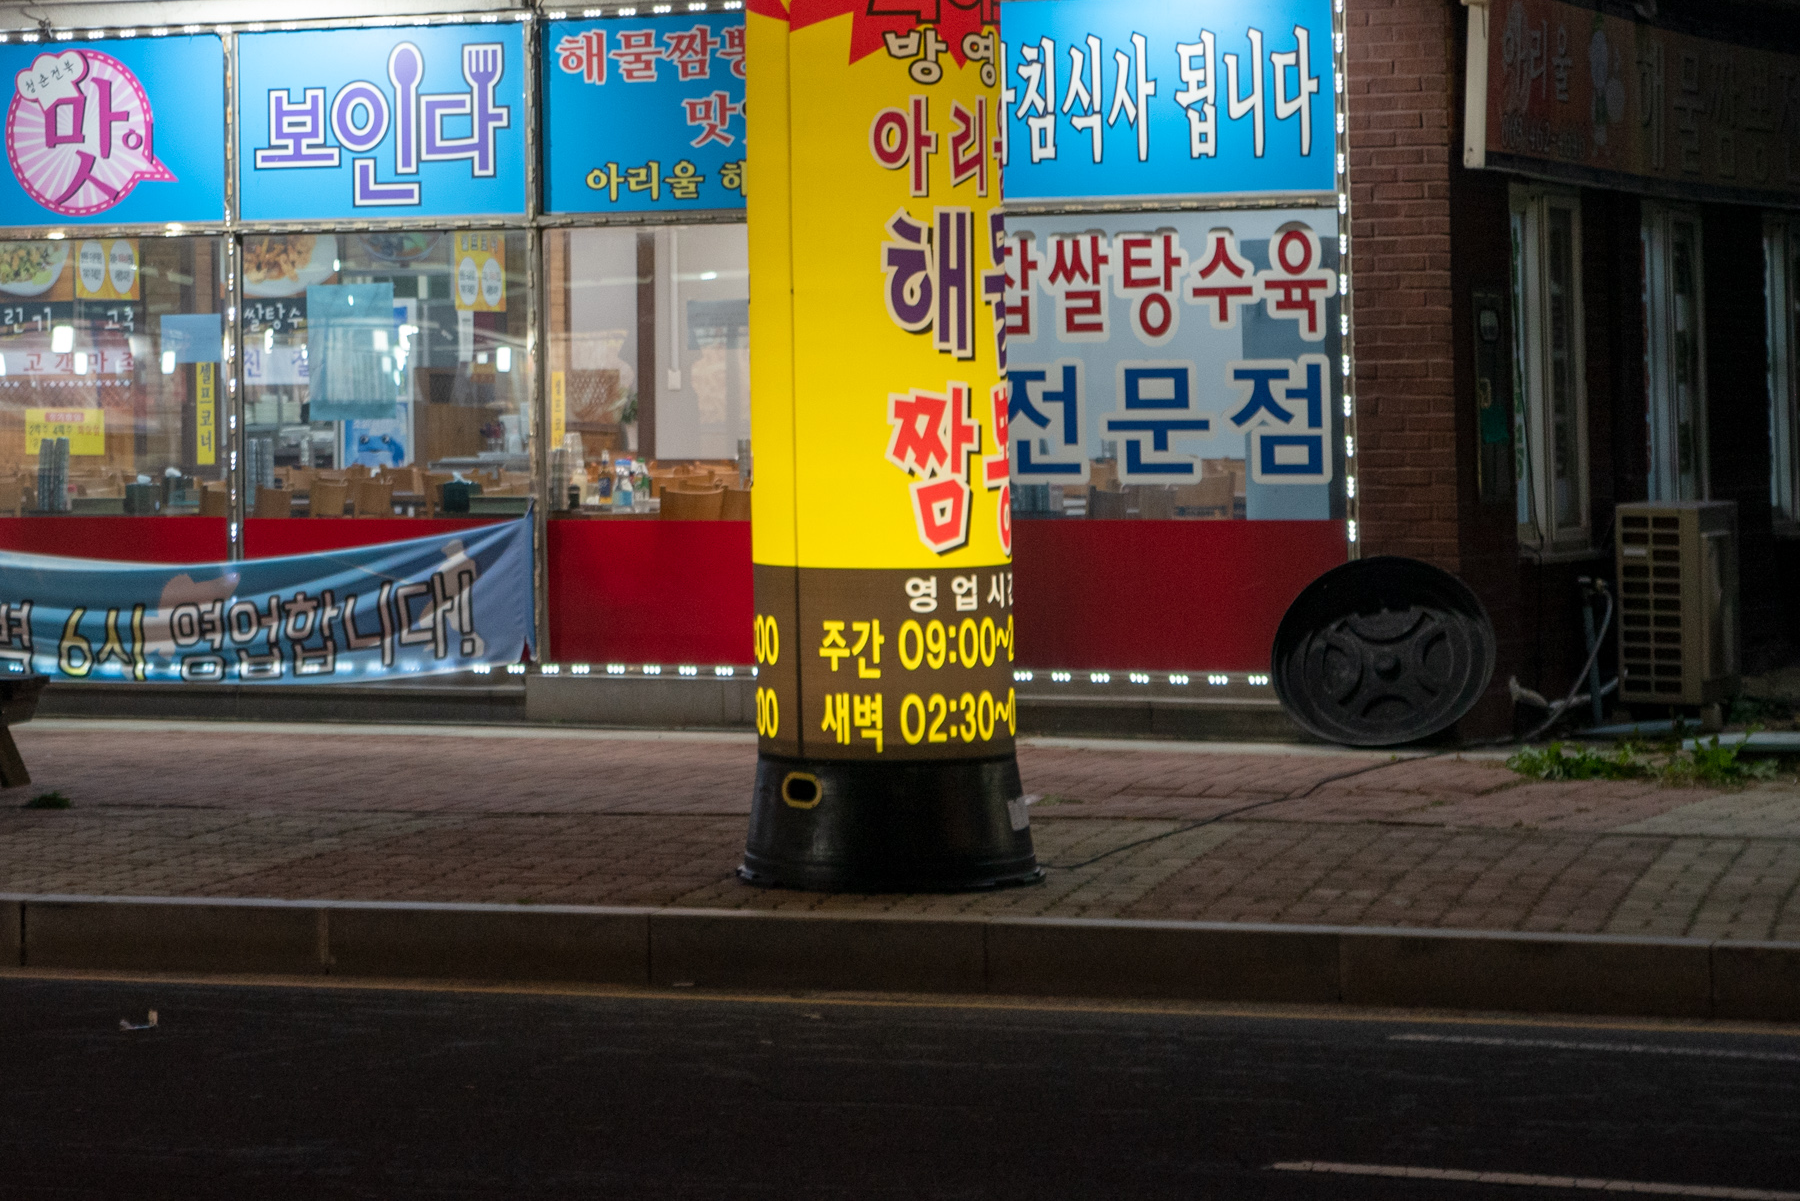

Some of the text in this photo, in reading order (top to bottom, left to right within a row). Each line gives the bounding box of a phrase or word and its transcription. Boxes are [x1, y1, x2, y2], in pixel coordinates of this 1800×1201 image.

[884, 24, 998, 87] 방영
[1173, 24, 1320, 159] 됩니다
[253, 41, 510, 208] 보인다
[682, 89, 747, 149] 맛
[868, 93, 1004, 198] 아리
[586, 161, 705, 202] 아리울
[1008, 362, 1325, 476] 전문점
[58, 601, 148, 682] 6시
[169, 567, 477, 682] 영업합니다!
[818, 618, 885, 679] 주간
[820, 691, 884, 754] 새벽
